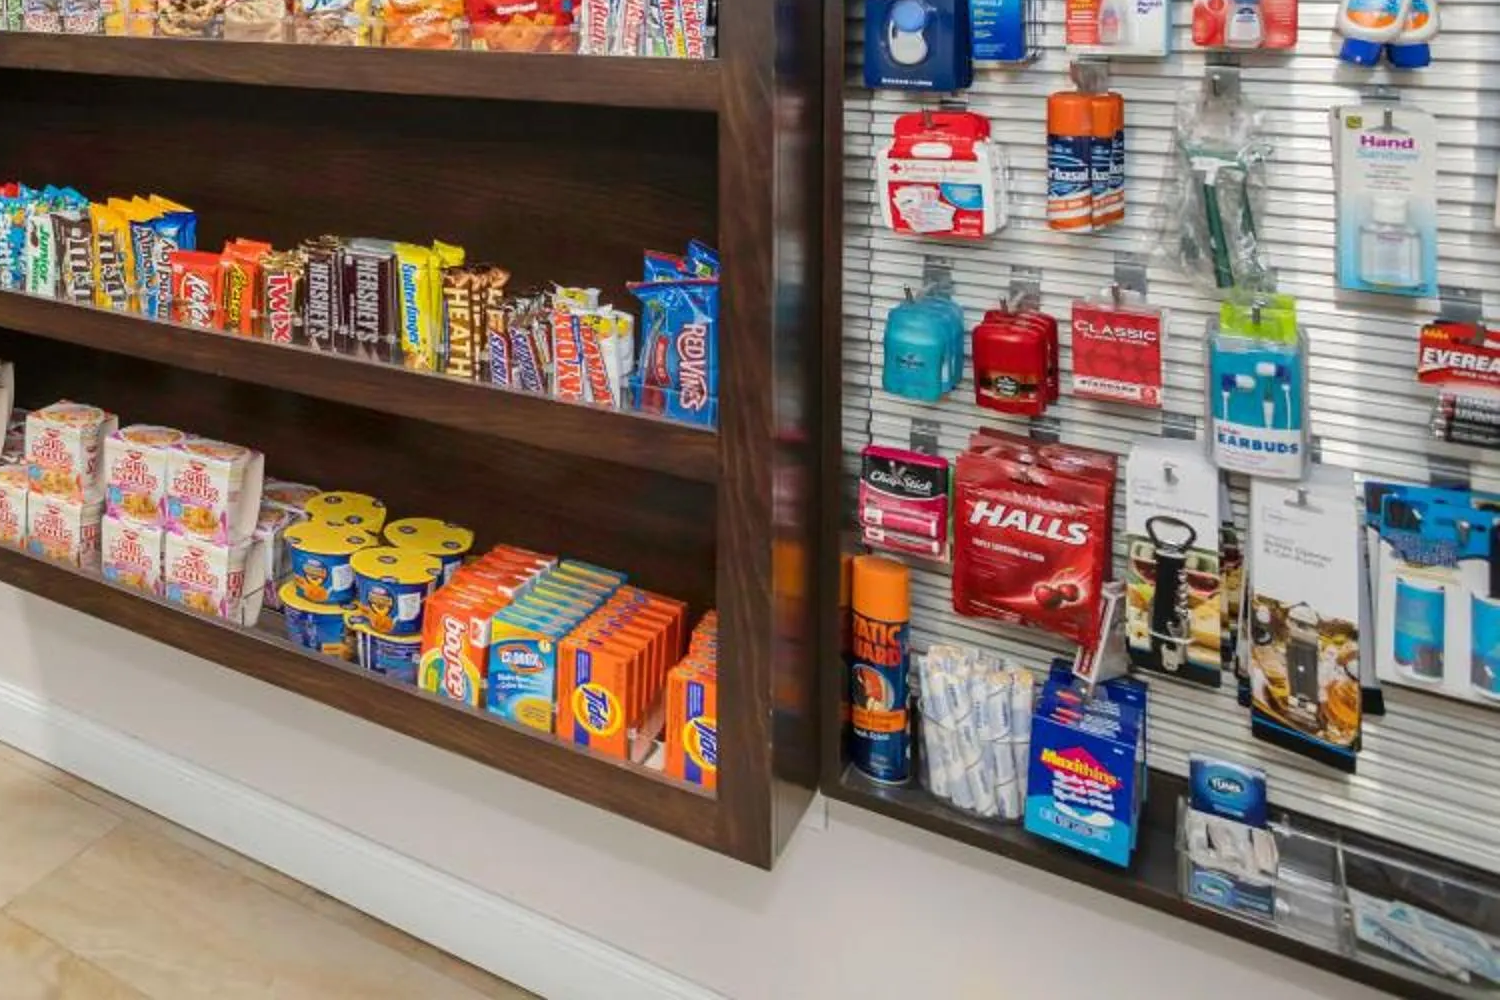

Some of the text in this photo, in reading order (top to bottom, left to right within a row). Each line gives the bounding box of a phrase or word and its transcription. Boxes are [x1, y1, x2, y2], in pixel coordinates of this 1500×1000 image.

[1360, 135, 1414, 150] Hand
[38, 224, 51, 284] Junior
[309, 262, 330, 340] HERSHEY'S
[356, 259, 380, 343] HERSHEY'S
[402, 262, 420, 346] Butterfinger
[442, 287, 473, 378] HEATH
[1075, 319, 1157, 341] CLASSIC
[1217, 432, 1299, 455] EARBUDS
[970, 500, 1090, 546] HALLS
[442, 615, 468, 700] bounce
[580, 683, 611, 732] Tide
[1041, 748, 1119, 786] Maxithins
[1211, 776, 1241, 793] TUMS
